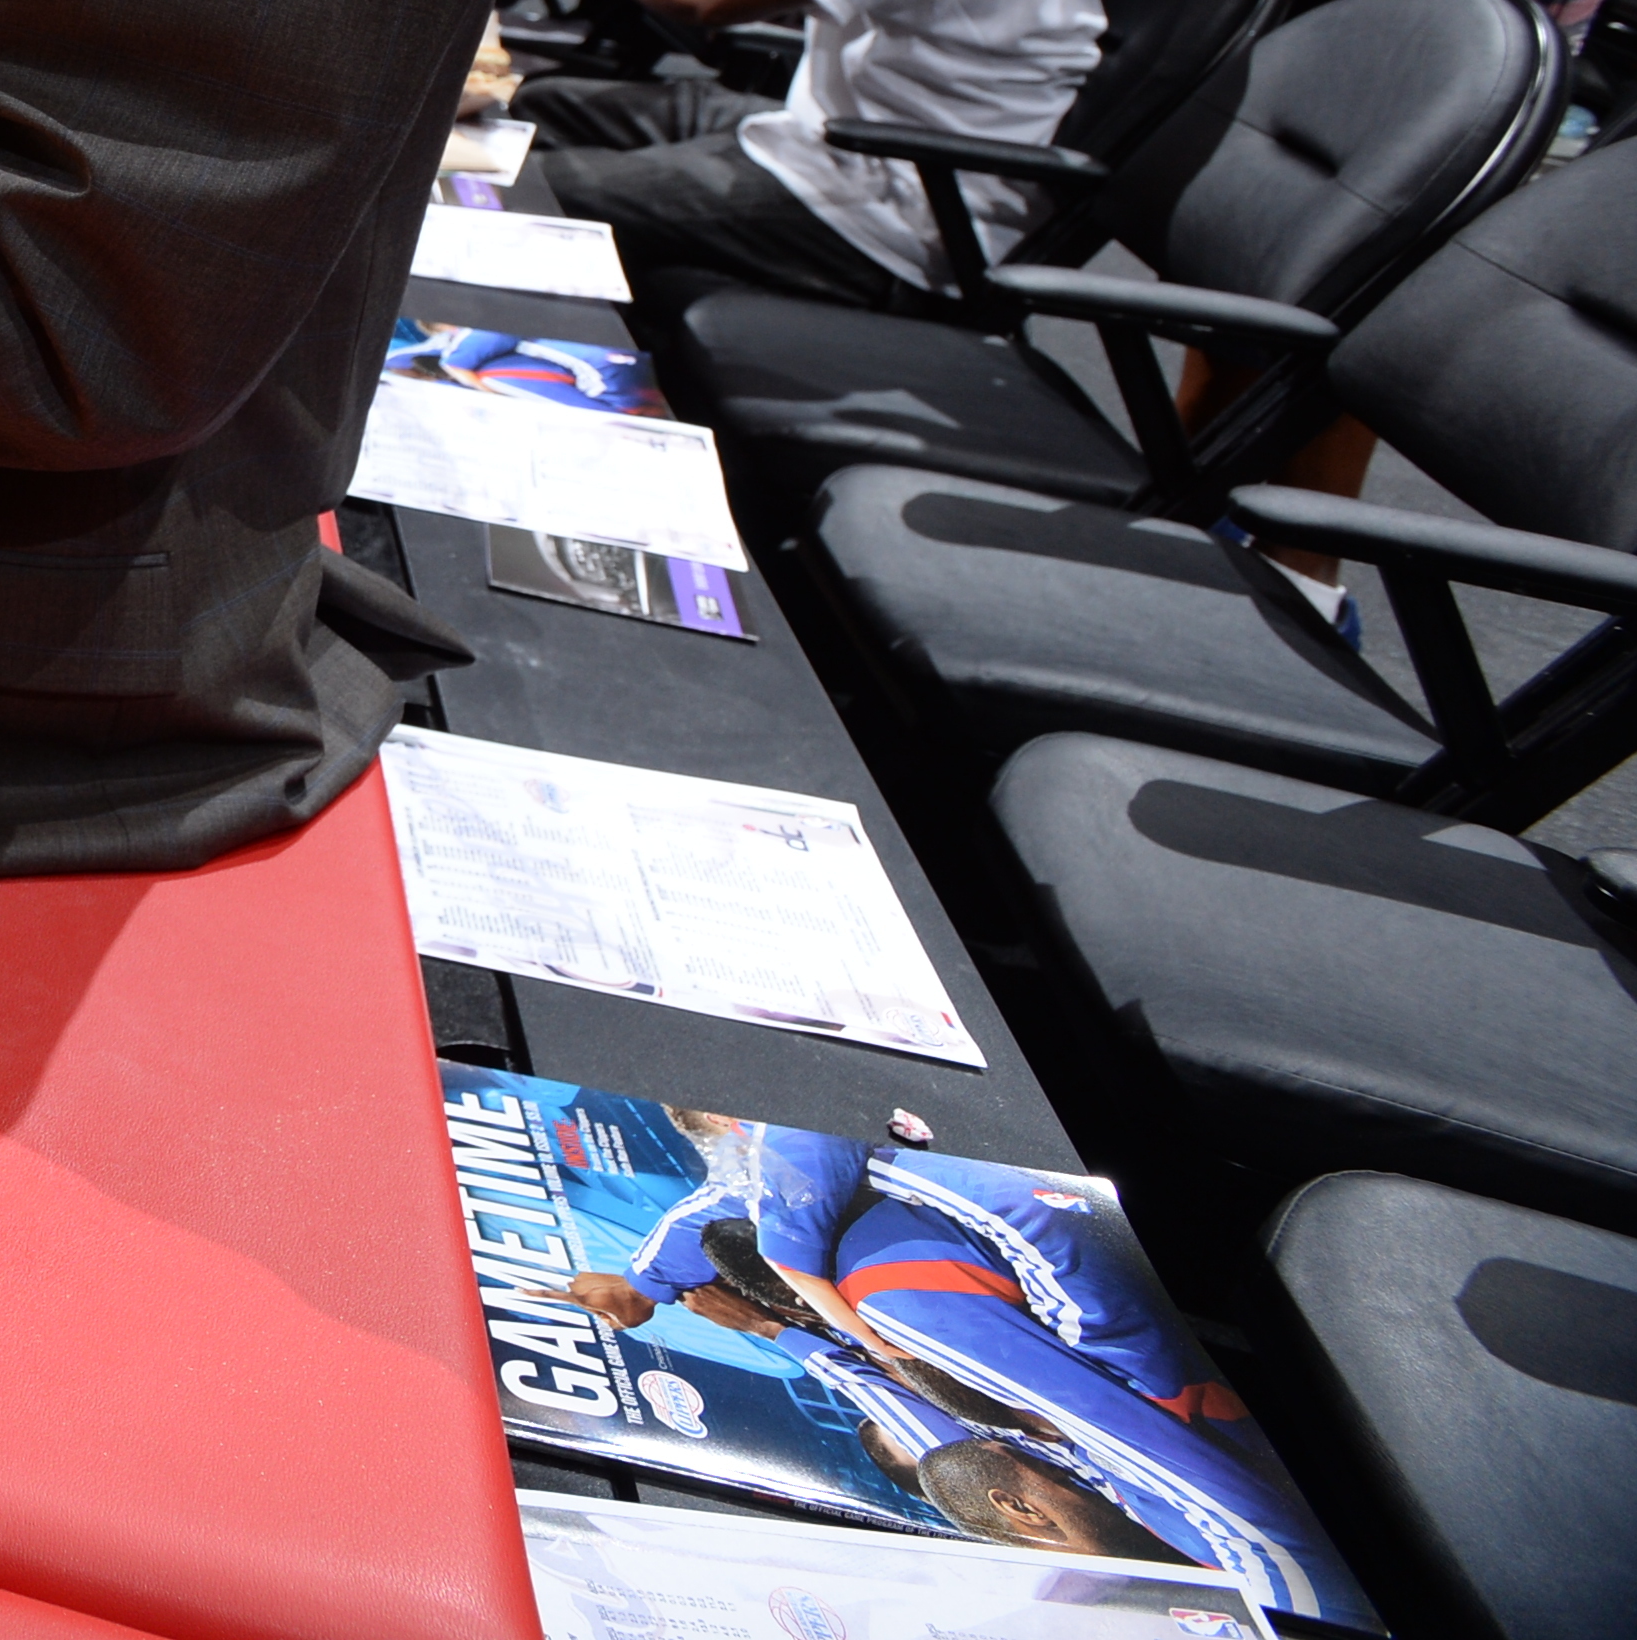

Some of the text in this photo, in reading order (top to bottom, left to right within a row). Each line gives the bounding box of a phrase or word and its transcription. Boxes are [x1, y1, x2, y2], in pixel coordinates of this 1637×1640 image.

[444, 1092, 620, 1418] GAMETIME
[603, 1341, 626, 1368] GAME
[610, 1367, 639, 1407] OFFICIAL
[623, 1405, 645, 1426] THE
[667, 1380, 704, 1435] CLIPPERS
[793, 1499, 809, 1511] THE
[809, 1502, 843, 1519] OFFICIAL
[866, 1514, 904, 1533] PROGRAM
